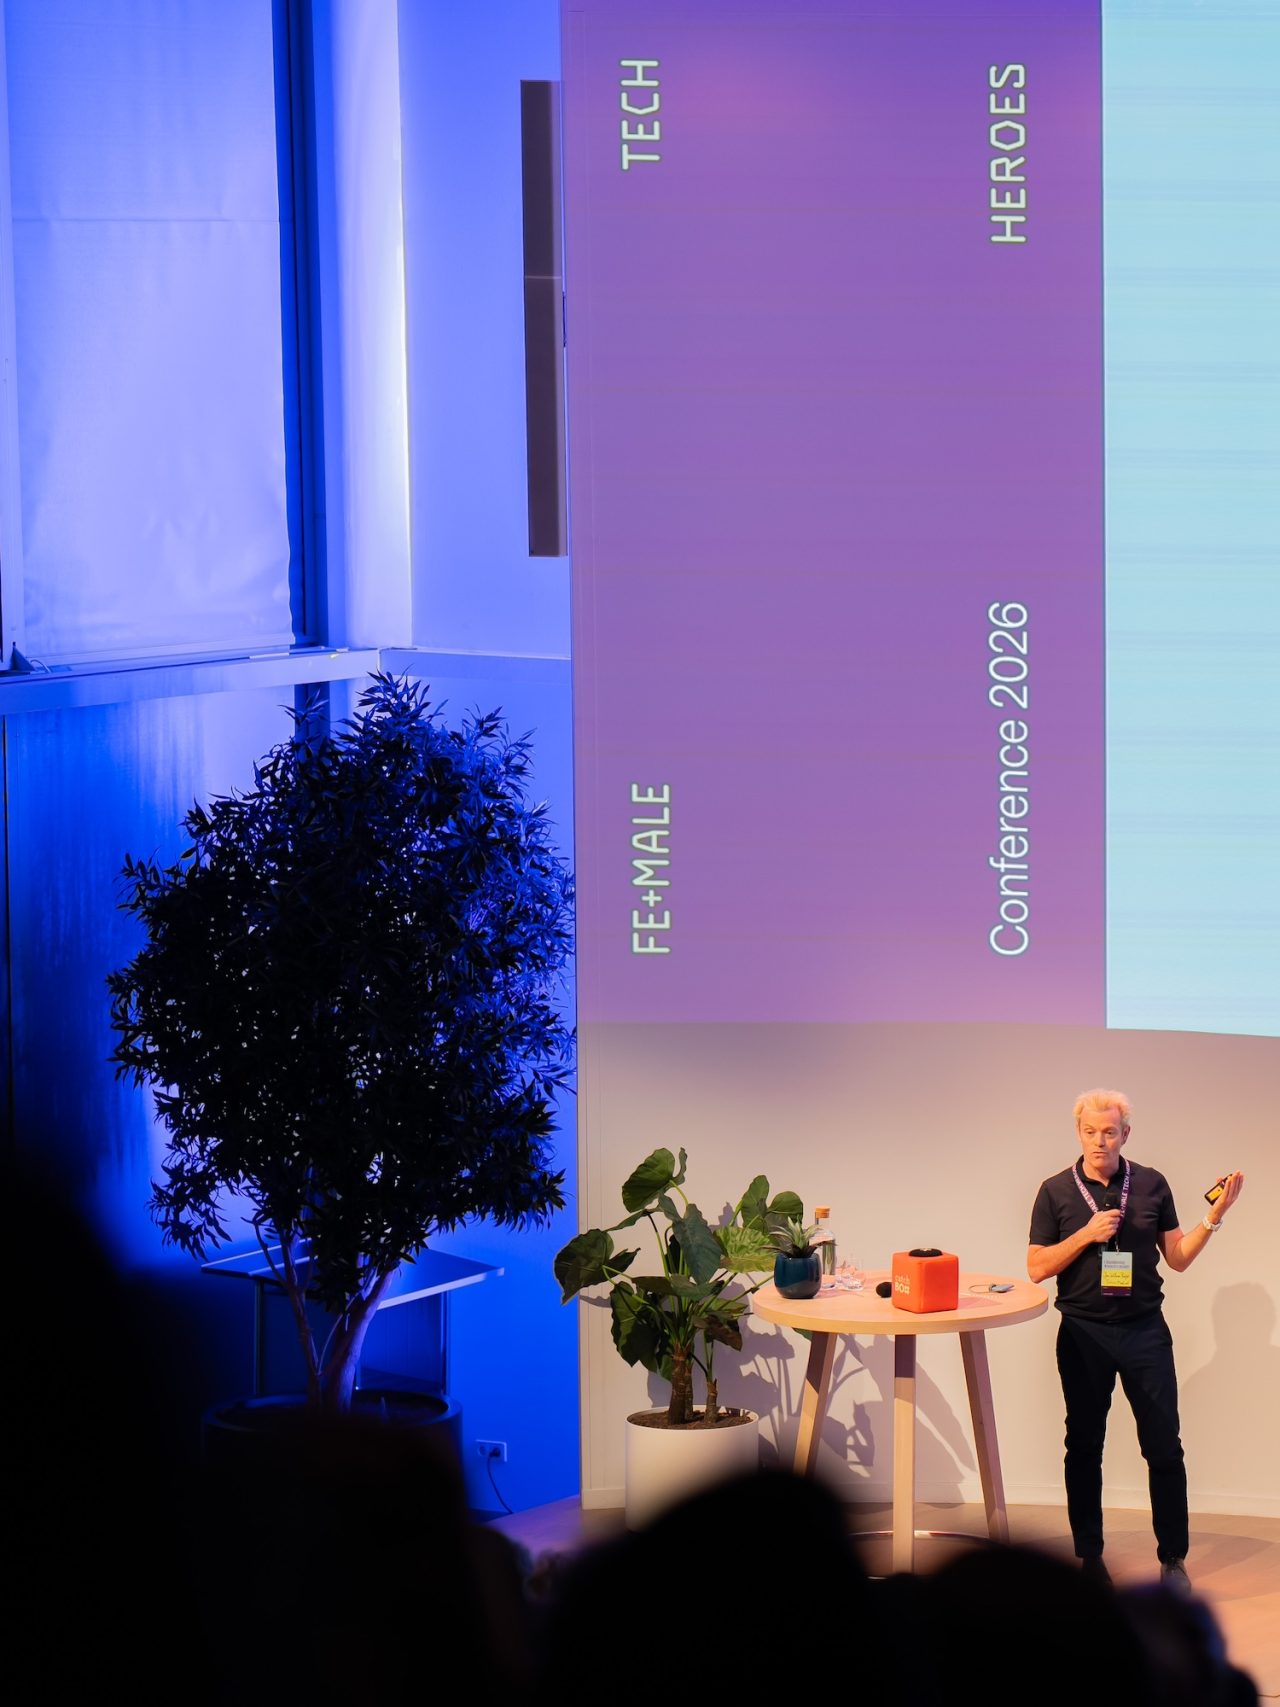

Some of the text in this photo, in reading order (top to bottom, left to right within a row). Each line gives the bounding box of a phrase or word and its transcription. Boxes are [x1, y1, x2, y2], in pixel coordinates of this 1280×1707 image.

[620, 58, 661, 171] TECH
[988, 63, 1027, 244] HEROES
[988, 602, 1029, 955] Conference 2026
[631, 783, 671, 954] FE+MALE
